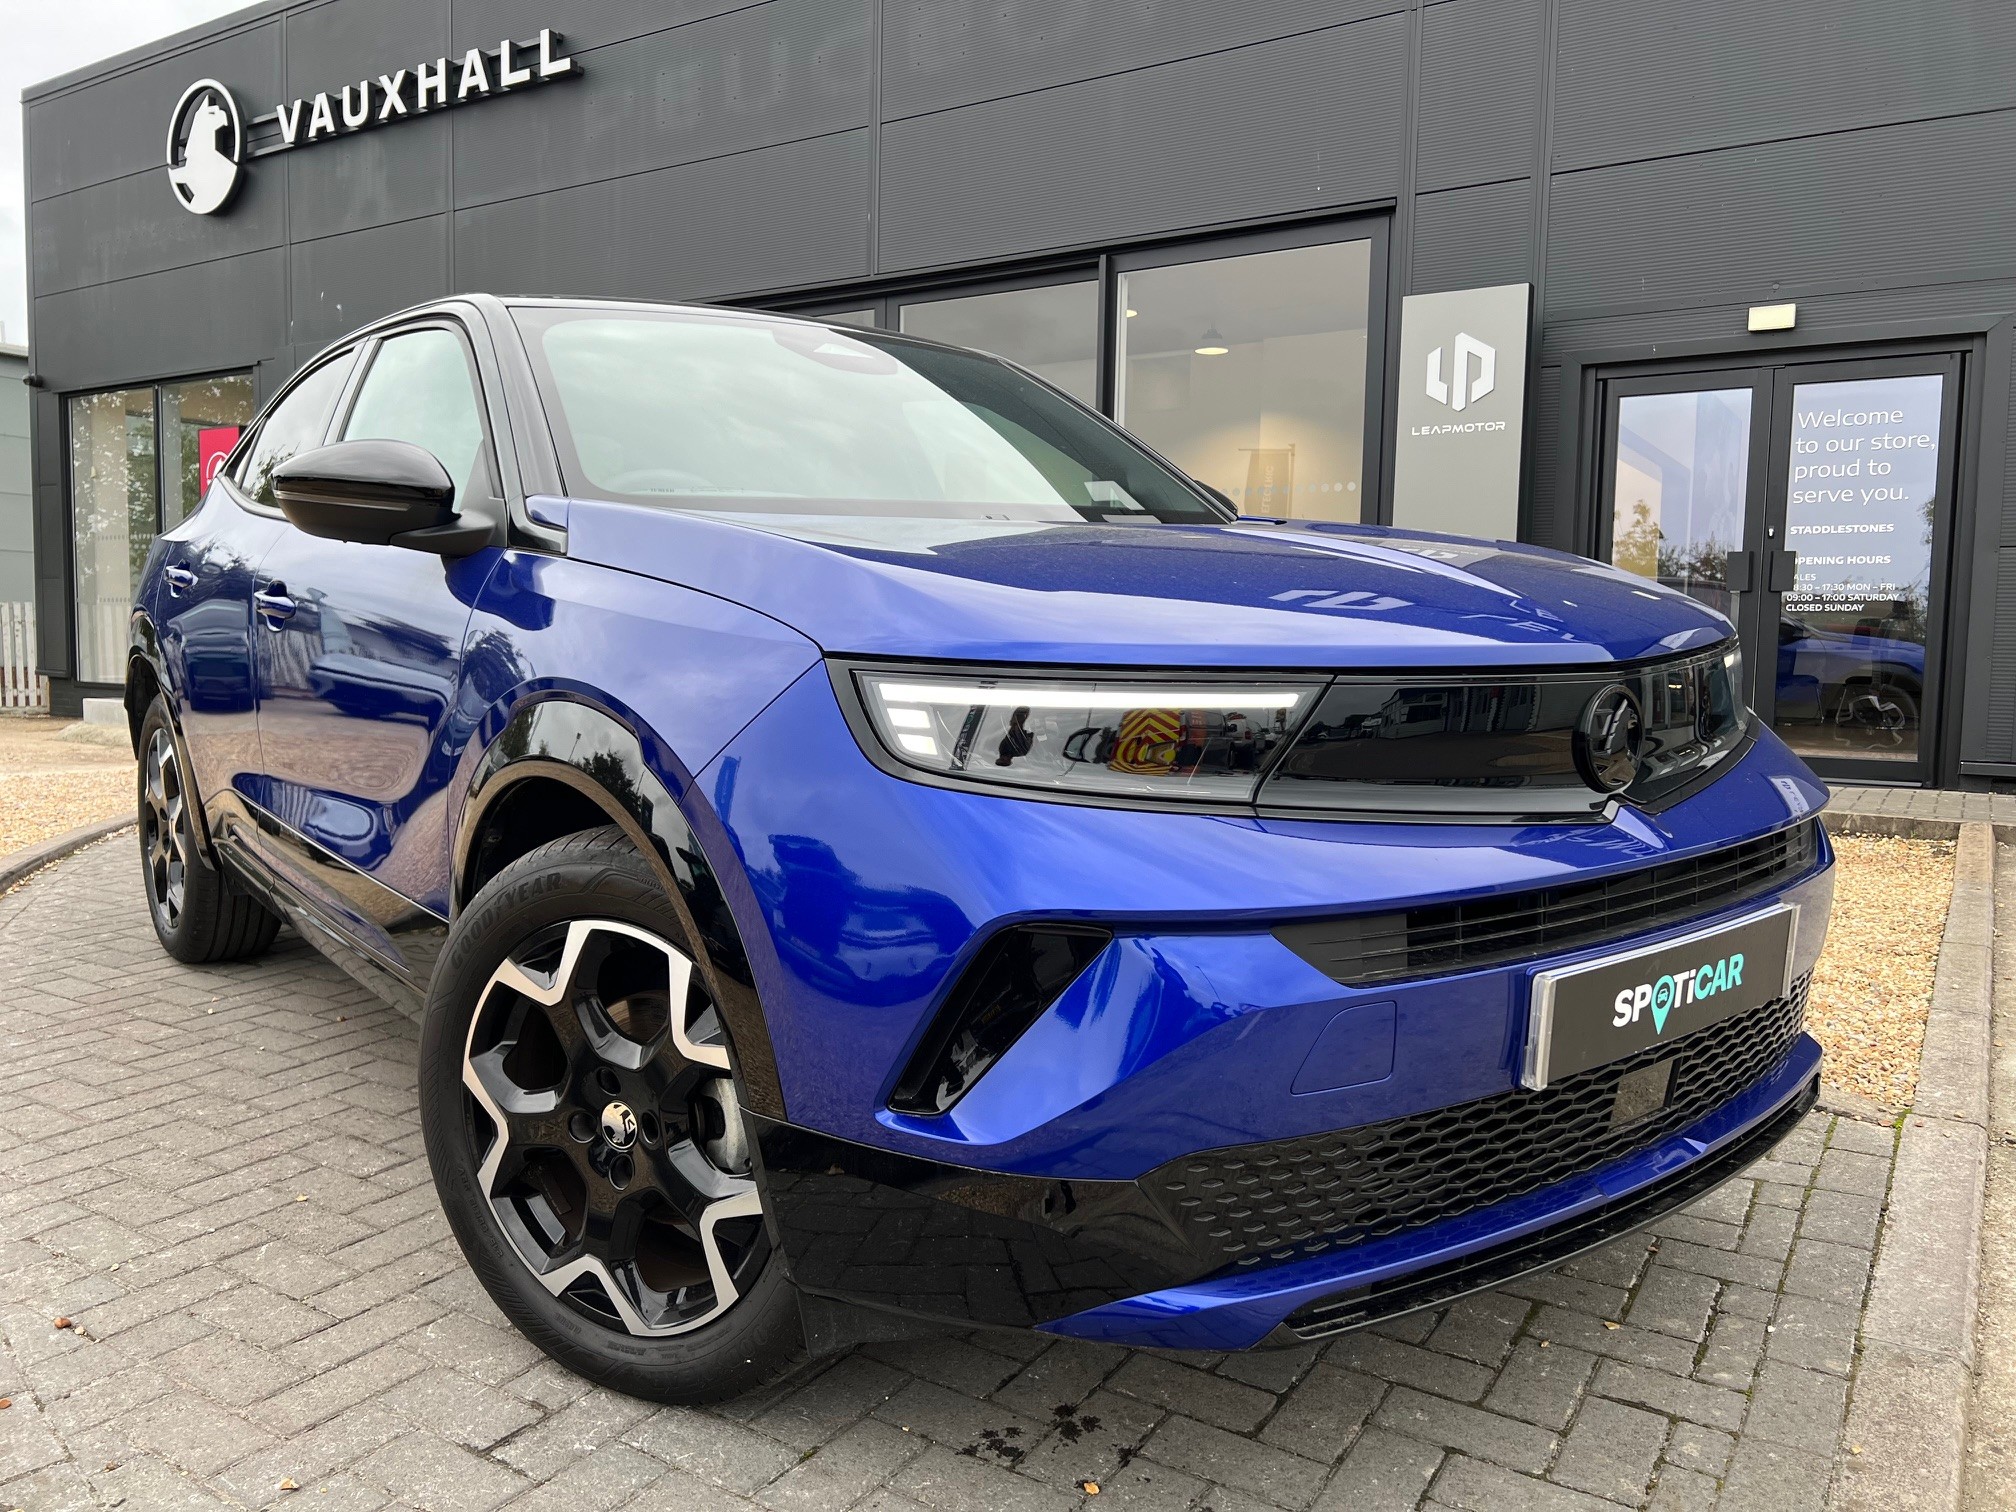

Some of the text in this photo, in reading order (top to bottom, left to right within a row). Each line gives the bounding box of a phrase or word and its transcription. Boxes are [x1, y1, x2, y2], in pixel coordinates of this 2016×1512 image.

[276, 28, 571, 144] VAUXHALL
[1798, 409, 1904, 429] Welcome
[1411, 421, 1506, 436] LEAPMOTOR
[1795, 432, 1936, 454] to our store,
[1794, 458, 1892, 483] proud to
[1792, 487, 1910, 505] serve you.
[1790, 523, 1895, 535] STADDLESTONES
[1794, 555, 1891, 565] PENING HOURS
[1794, 573, 1817, 581] ALES
[1793, 583, 1813, 591] 8:30
[1822, 583, 1845, 591] 17:30
[1847, 583, 1871, 591] MON
[1786, 593, 1813, 601] 09:00
[1822, 593, 1846, 601] 17:00
[1847, 593, 1899, 601] SATURDAY
[1785, 603, 1865, 611] CLOSED SUNDAY
